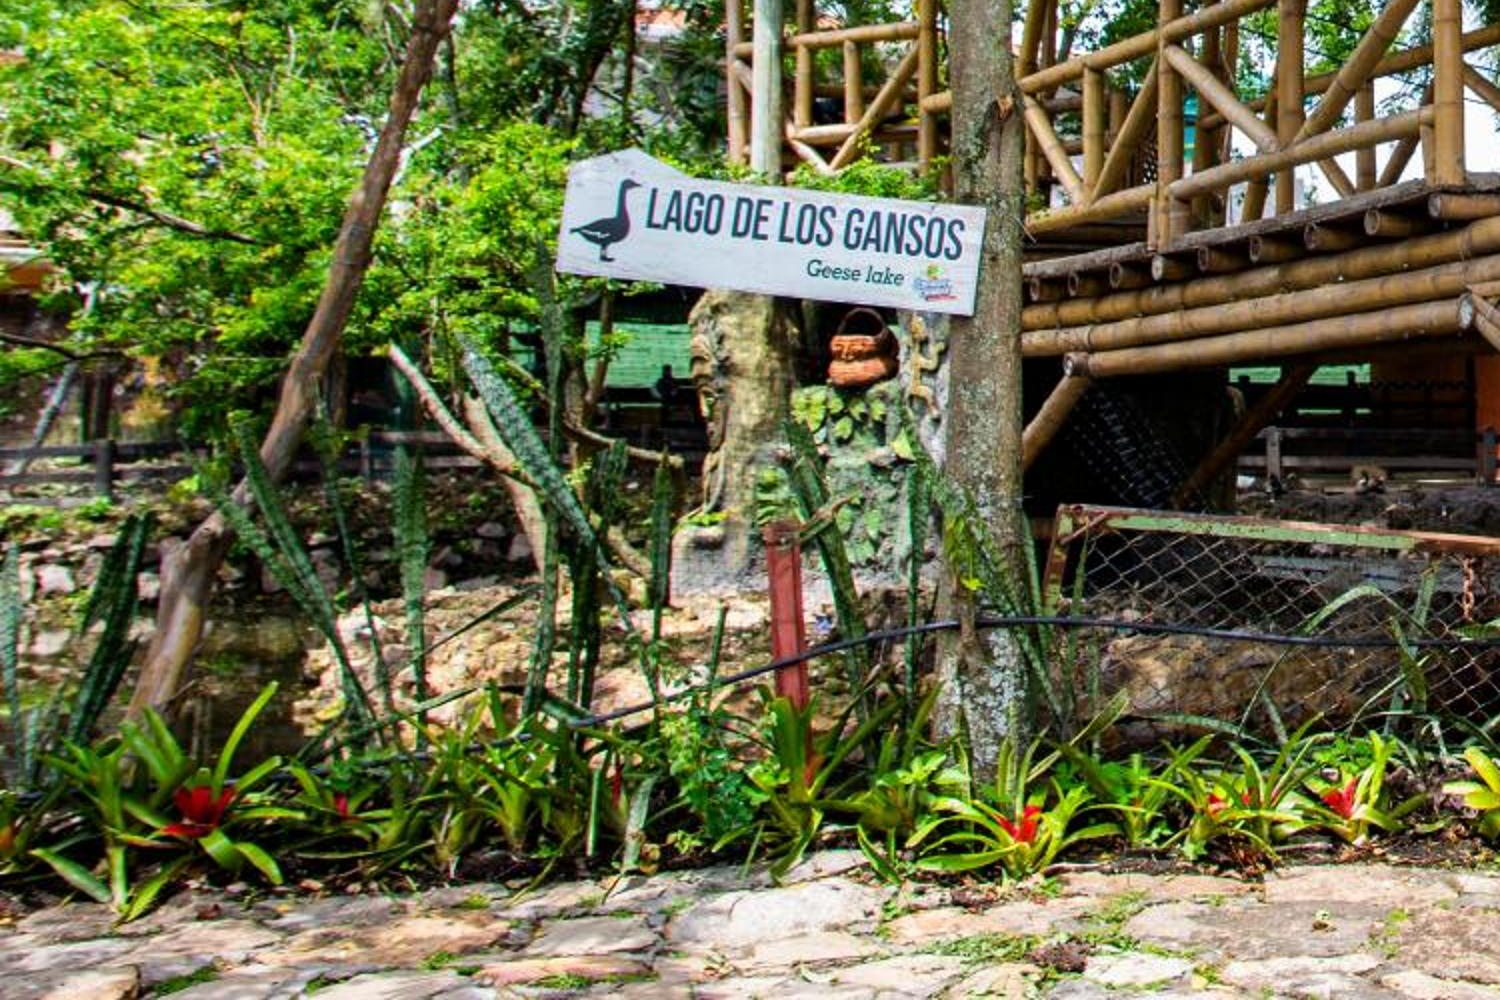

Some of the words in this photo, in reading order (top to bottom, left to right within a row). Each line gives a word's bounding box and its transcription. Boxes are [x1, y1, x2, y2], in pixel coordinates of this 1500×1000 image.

[645, 187, 725, 236] LAGO
[731, 197, 773, 241] DE
[779, 202, 836, 247] LOS
[843, 208, 966, 261] GANSOS
[807, 259, 861, 283] Geese
[865, 263, 905, 287] lake
